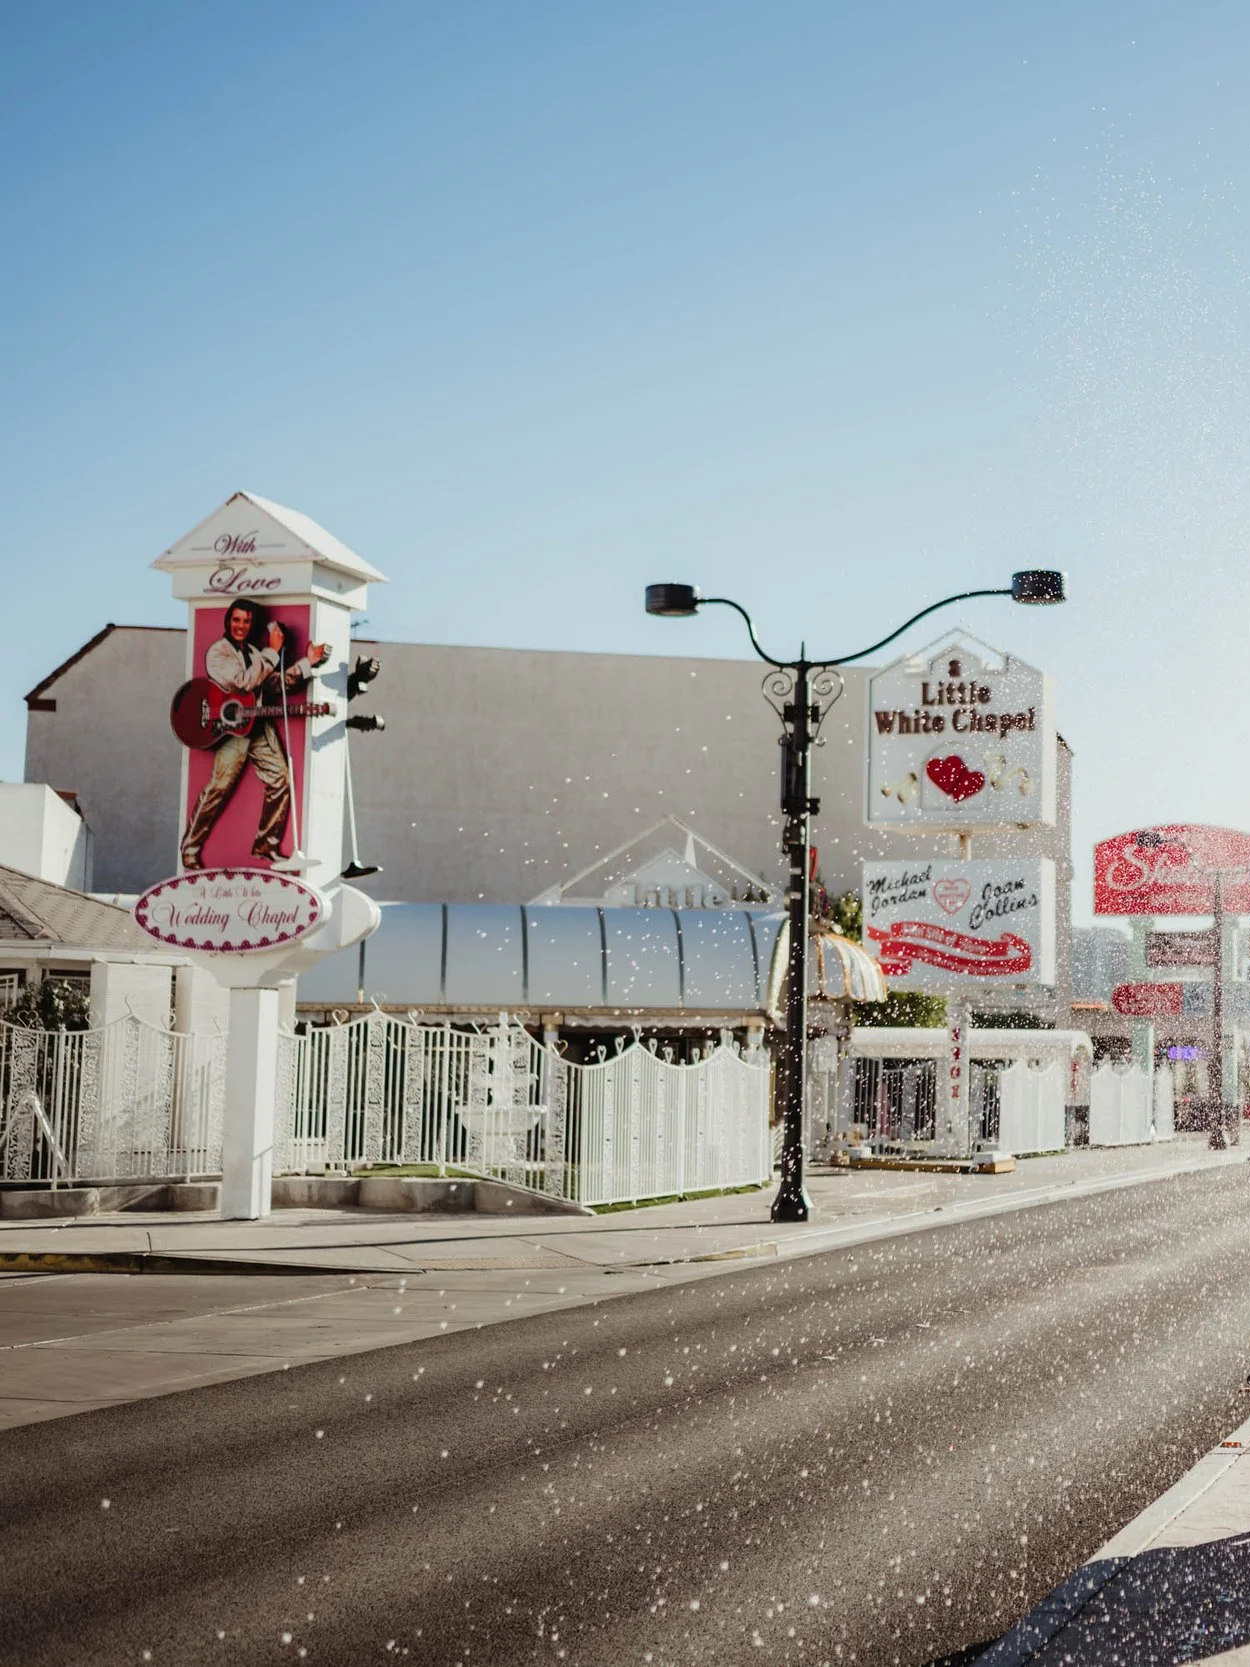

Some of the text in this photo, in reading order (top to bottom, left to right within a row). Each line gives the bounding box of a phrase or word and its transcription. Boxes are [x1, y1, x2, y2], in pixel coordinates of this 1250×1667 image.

[214, 530, 259, 554] With
[203, 566, 281, 595] Love
[921, 681, 991, 706] Little
[874, 706, 1036, 739] White Chapel
[867, 864, 932, 894] Michael
[981, 877, 1025, 901] Joan
[152, 900, 299, 933] Wedding Chapel
[871, 888, 927, 917] Jordan
[968, 893, 1038, 930] Collins
